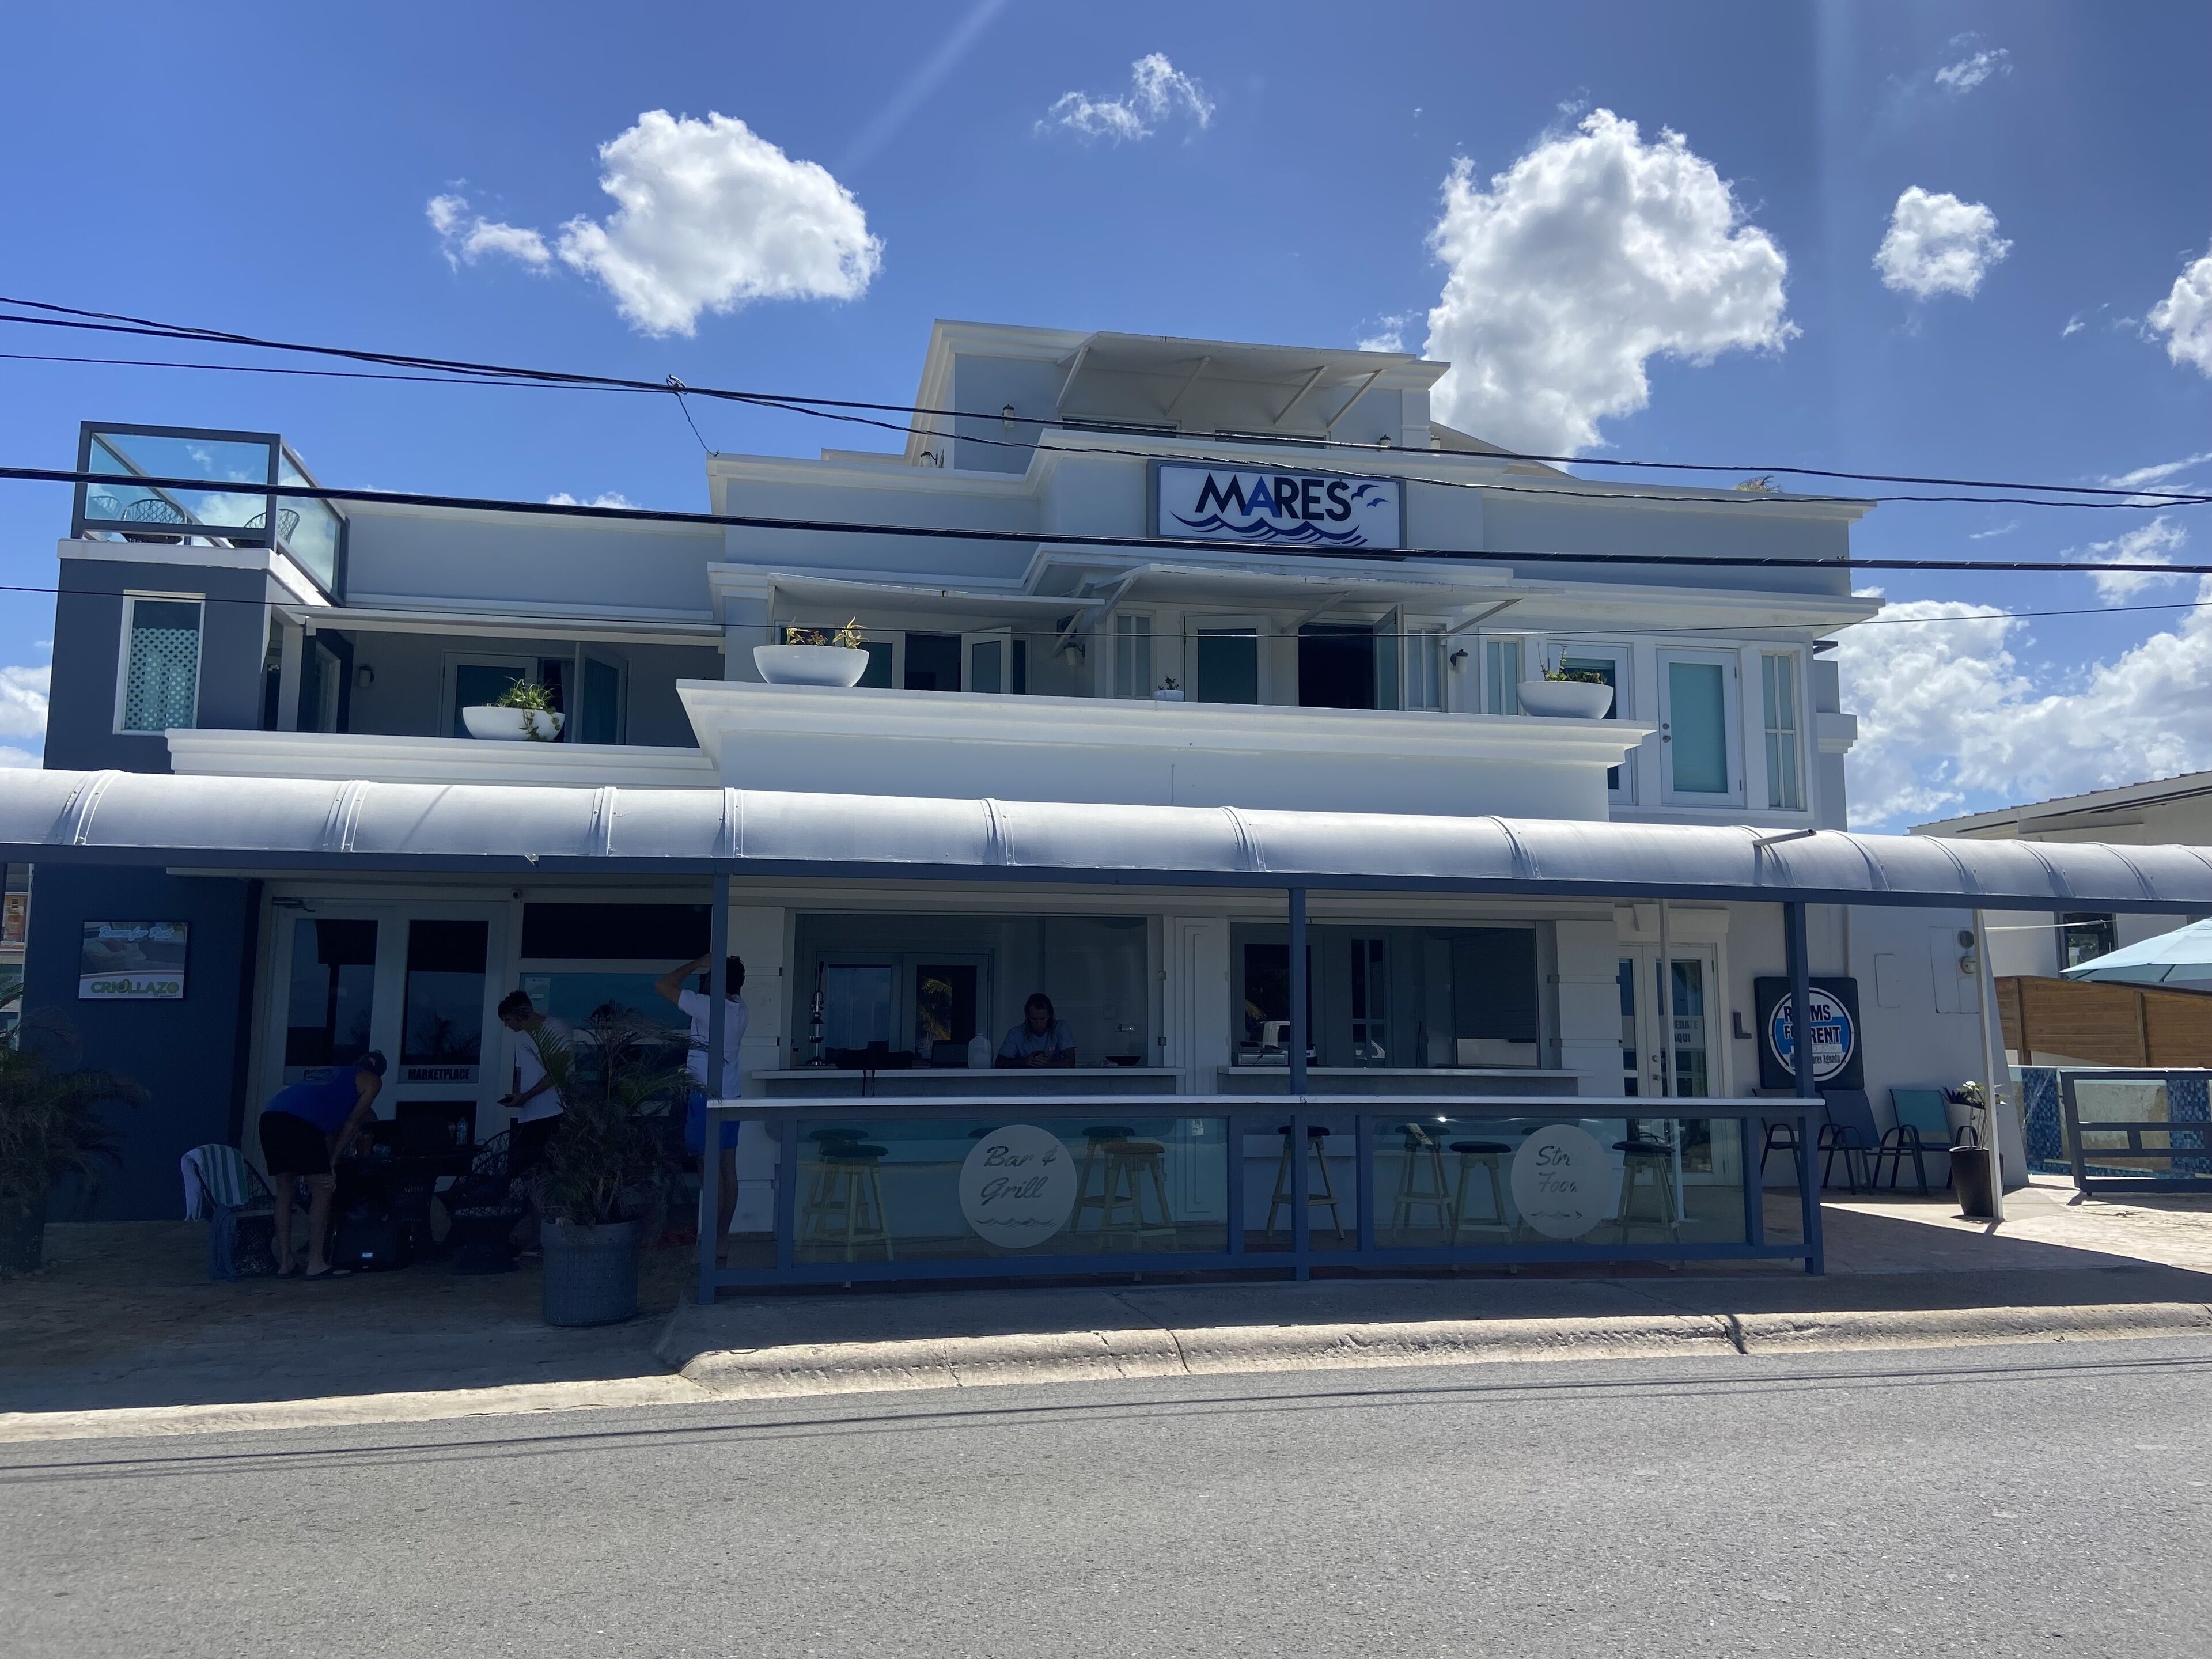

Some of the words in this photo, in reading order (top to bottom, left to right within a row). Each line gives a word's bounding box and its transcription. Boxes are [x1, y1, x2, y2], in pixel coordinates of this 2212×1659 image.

[1194, 472, 1351, 521] MARES
[149, 926, 175, 938] Rent
[90, 979, 180, 994] CRIOLLAZO
[1783, 1004, 1831, 1022] RMS
[1674, 1020, 1698, 1029] EDATE
[408, 1069, 470, 1080] MARKETPLACE
[983, 1145, 1035, 1167] Bar
[980, 1176, 1049, 1206] Grill
